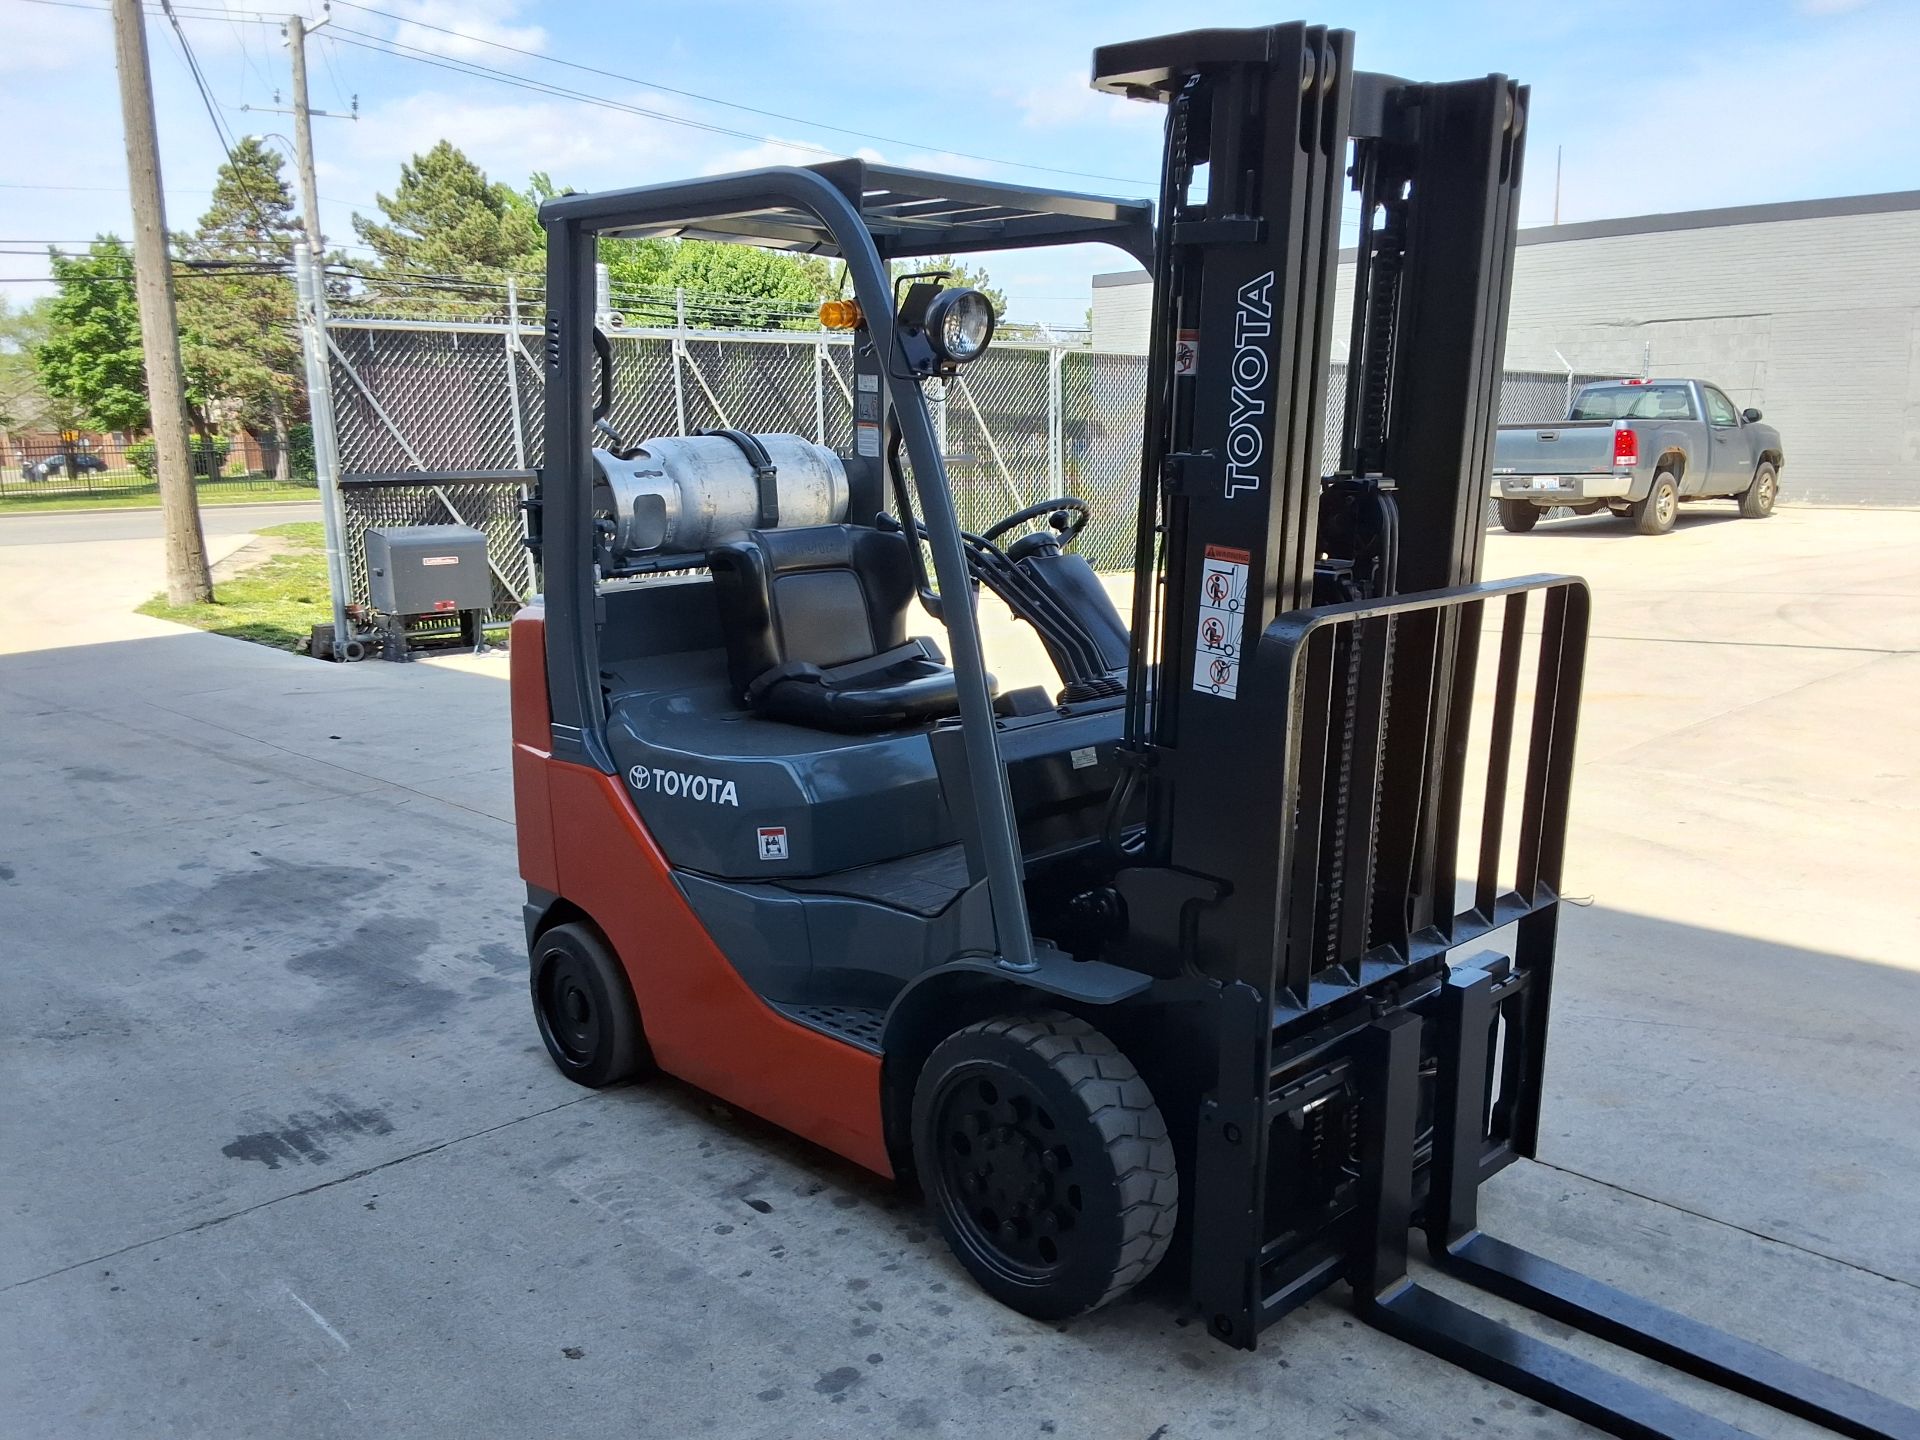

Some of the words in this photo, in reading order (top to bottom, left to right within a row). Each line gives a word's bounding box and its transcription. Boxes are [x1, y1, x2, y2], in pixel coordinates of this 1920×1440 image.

[1225, 271, 1274, 499] TOYOTA
[1216, 550, 1249, 562] WARNING
[652, 768, 739, 807] TOYOTA
